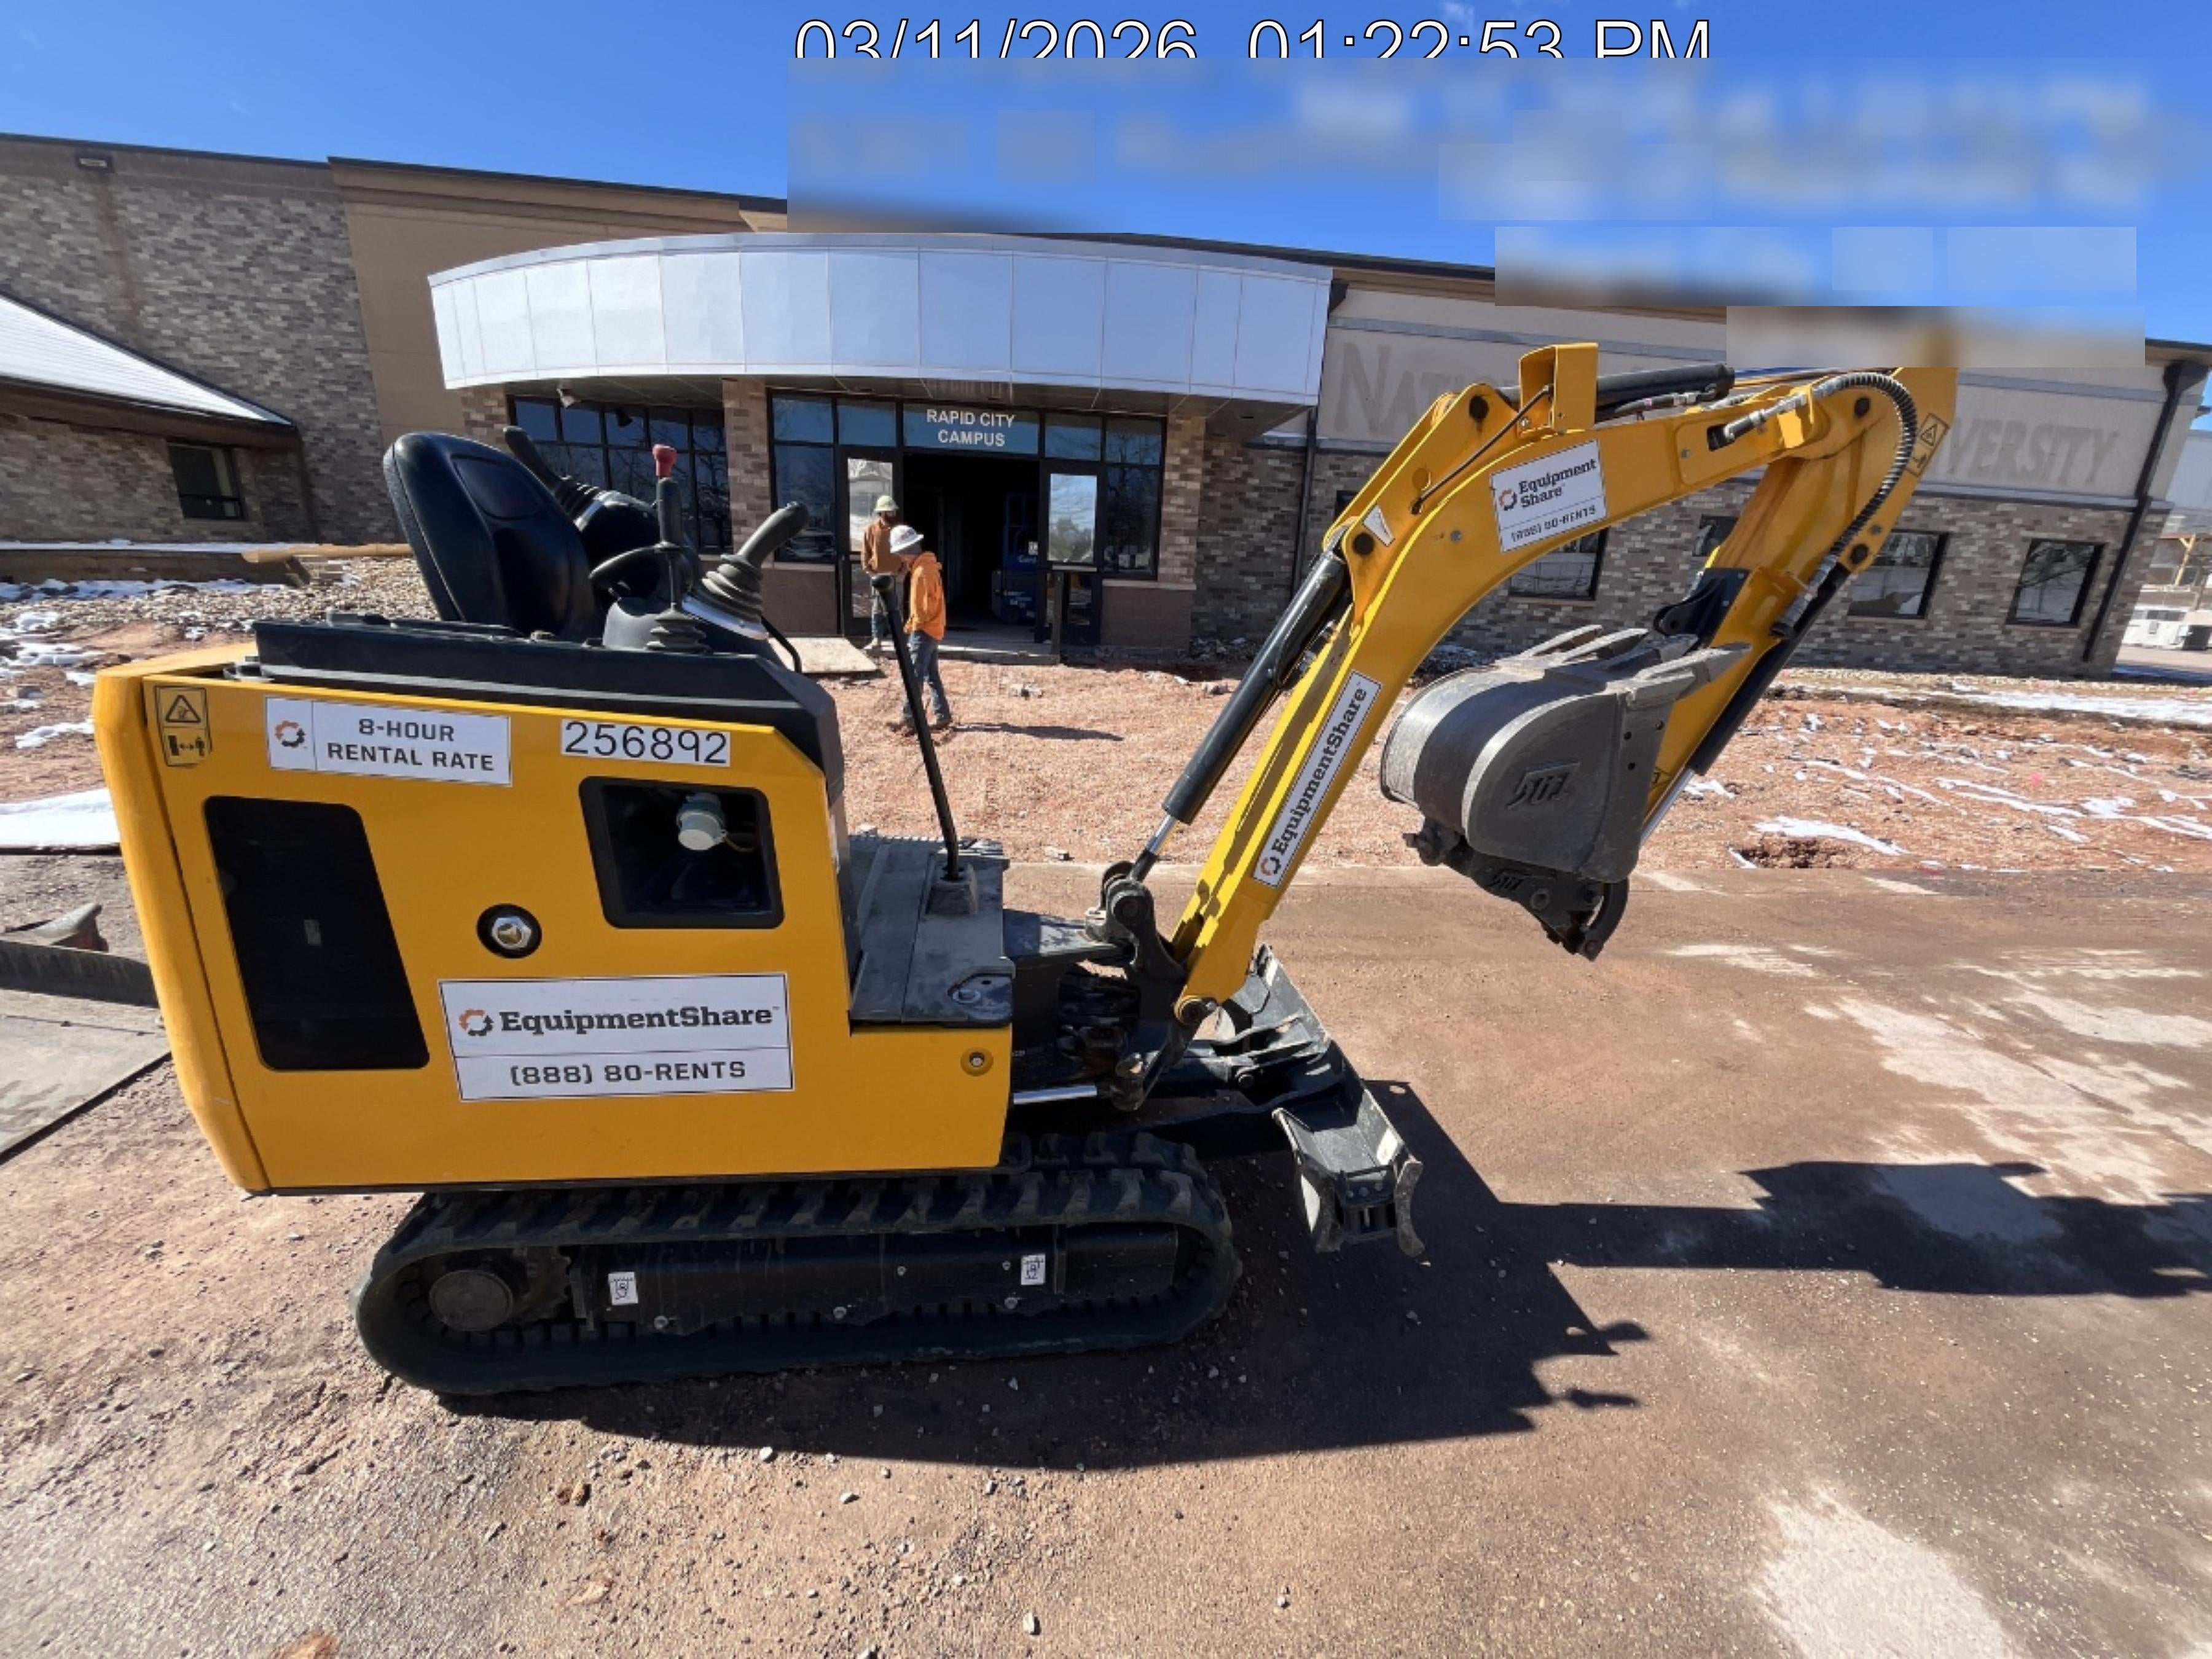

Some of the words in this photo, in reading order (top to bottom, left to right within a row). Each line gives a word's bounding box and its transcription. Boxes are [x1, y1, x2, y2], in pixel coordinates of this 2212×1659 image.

[926, 408, 975, 425] RAPID
[979, 412, 1016, 428] CITY
[938, 429, 1006, 447] CAMPUS
[1518, 459, 1598, 495] Equipment
[1521, 485, 1563, 509] Share
[358, 718, 455, 742] 8-HOUR
[564, 721, 728, 764] 256892
[327, 742, 423, 767] RENTAL
[433, 749, 493, 772] RATE
[1272, 688, 1367, 855] EquipmentShare
[500, 1005, 773, 1035] EquipmentShare
[511, 1064, 593, 1086] (888)
[604, 1061, 746, 1082] 80-RENTS
